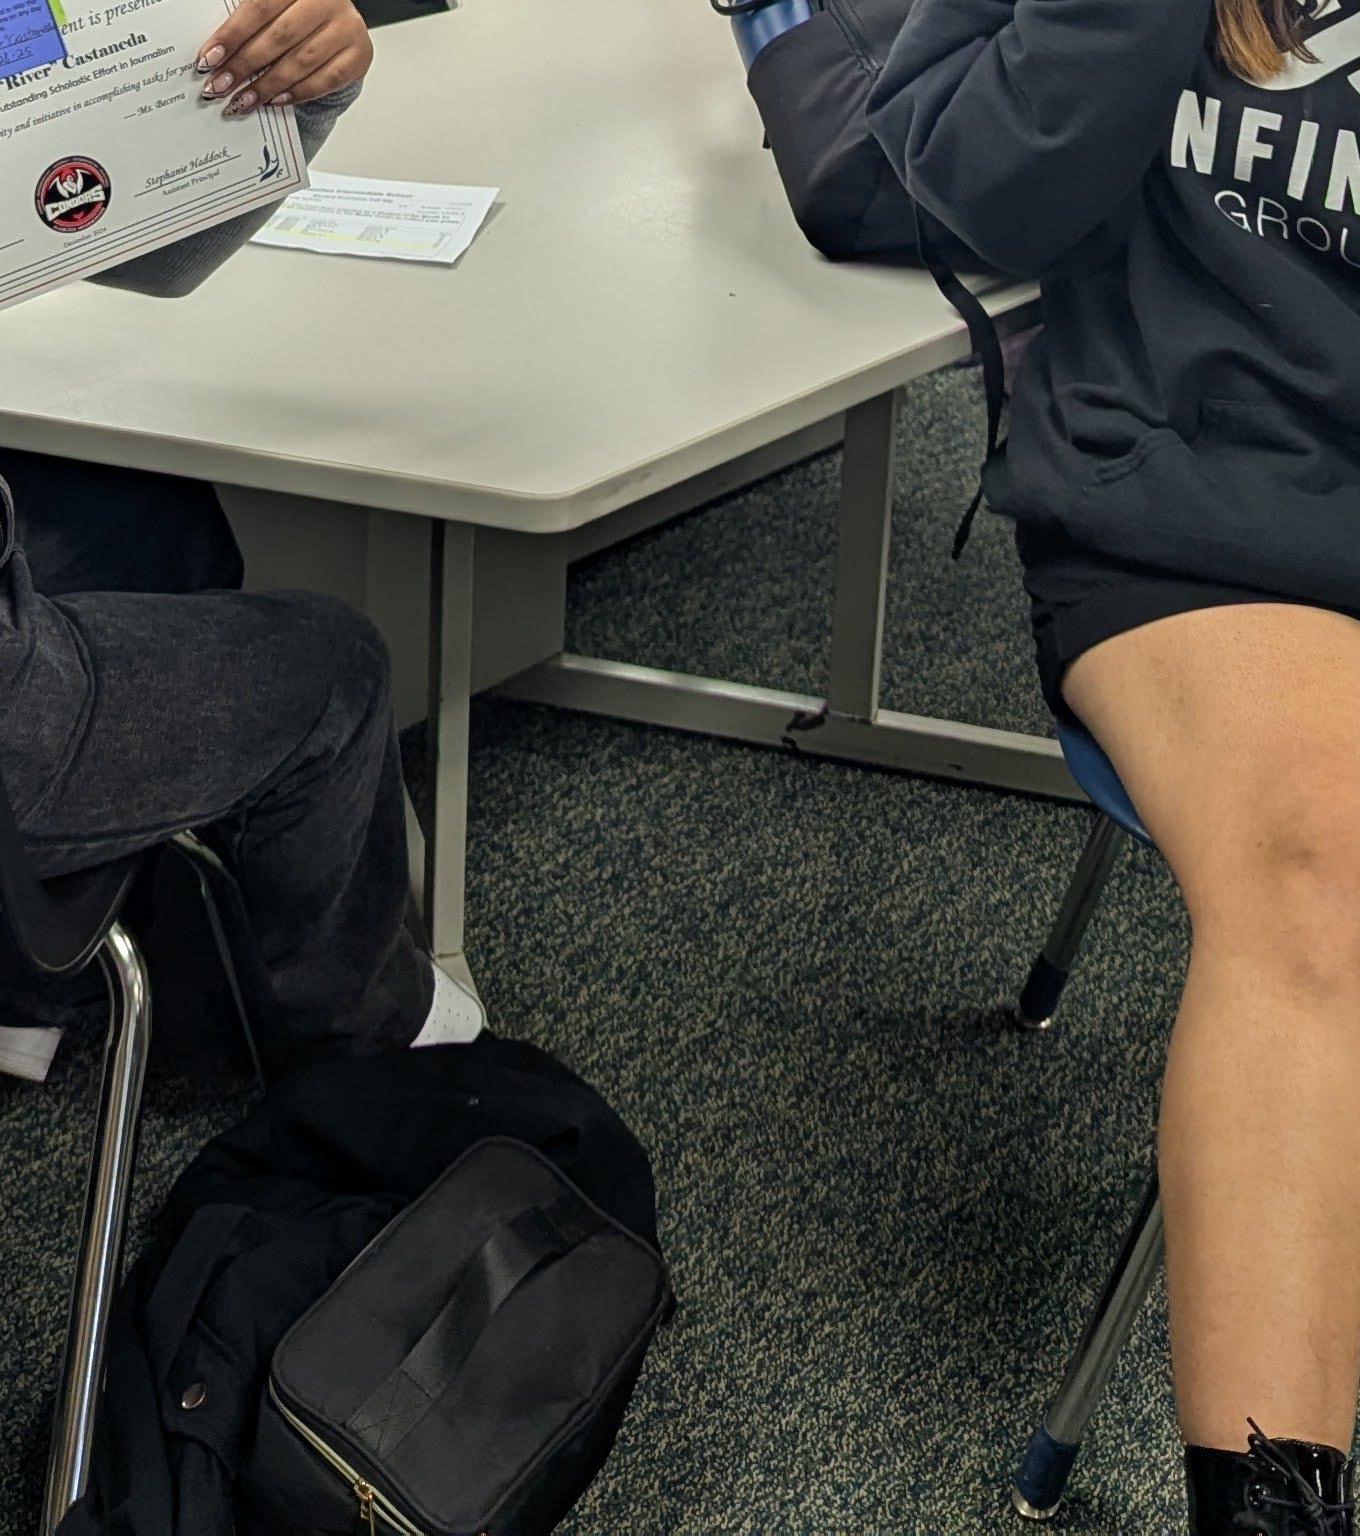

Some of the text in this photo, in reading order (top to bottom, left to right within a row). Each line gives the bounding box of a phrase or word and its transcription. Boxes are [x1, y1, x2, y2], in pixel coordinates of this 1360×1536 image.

[88, 10, 102, 26] is
[48, 74, 92, 95] Scholastic
[91, 64, 119, 80] Effort
[118, 61, 129, 70] in
[129, 45, 176, 68] Journalism
[58, 32, 148, 70] Castaneda
[14, 116, 31, 133] and
[29, 106, 72, 126] initiative
[72, 102, 82, 111] in
[83, 81, 141, 108] accomplishing
[142, 71, 164, 87] tasks
[164, 67, 181, 82] for
[136, 92, 186, 117] Ms. Becerra
[145, 145, 234, 189] Stephanie Haddock
[44, 184, 107, 221] CONDORS
